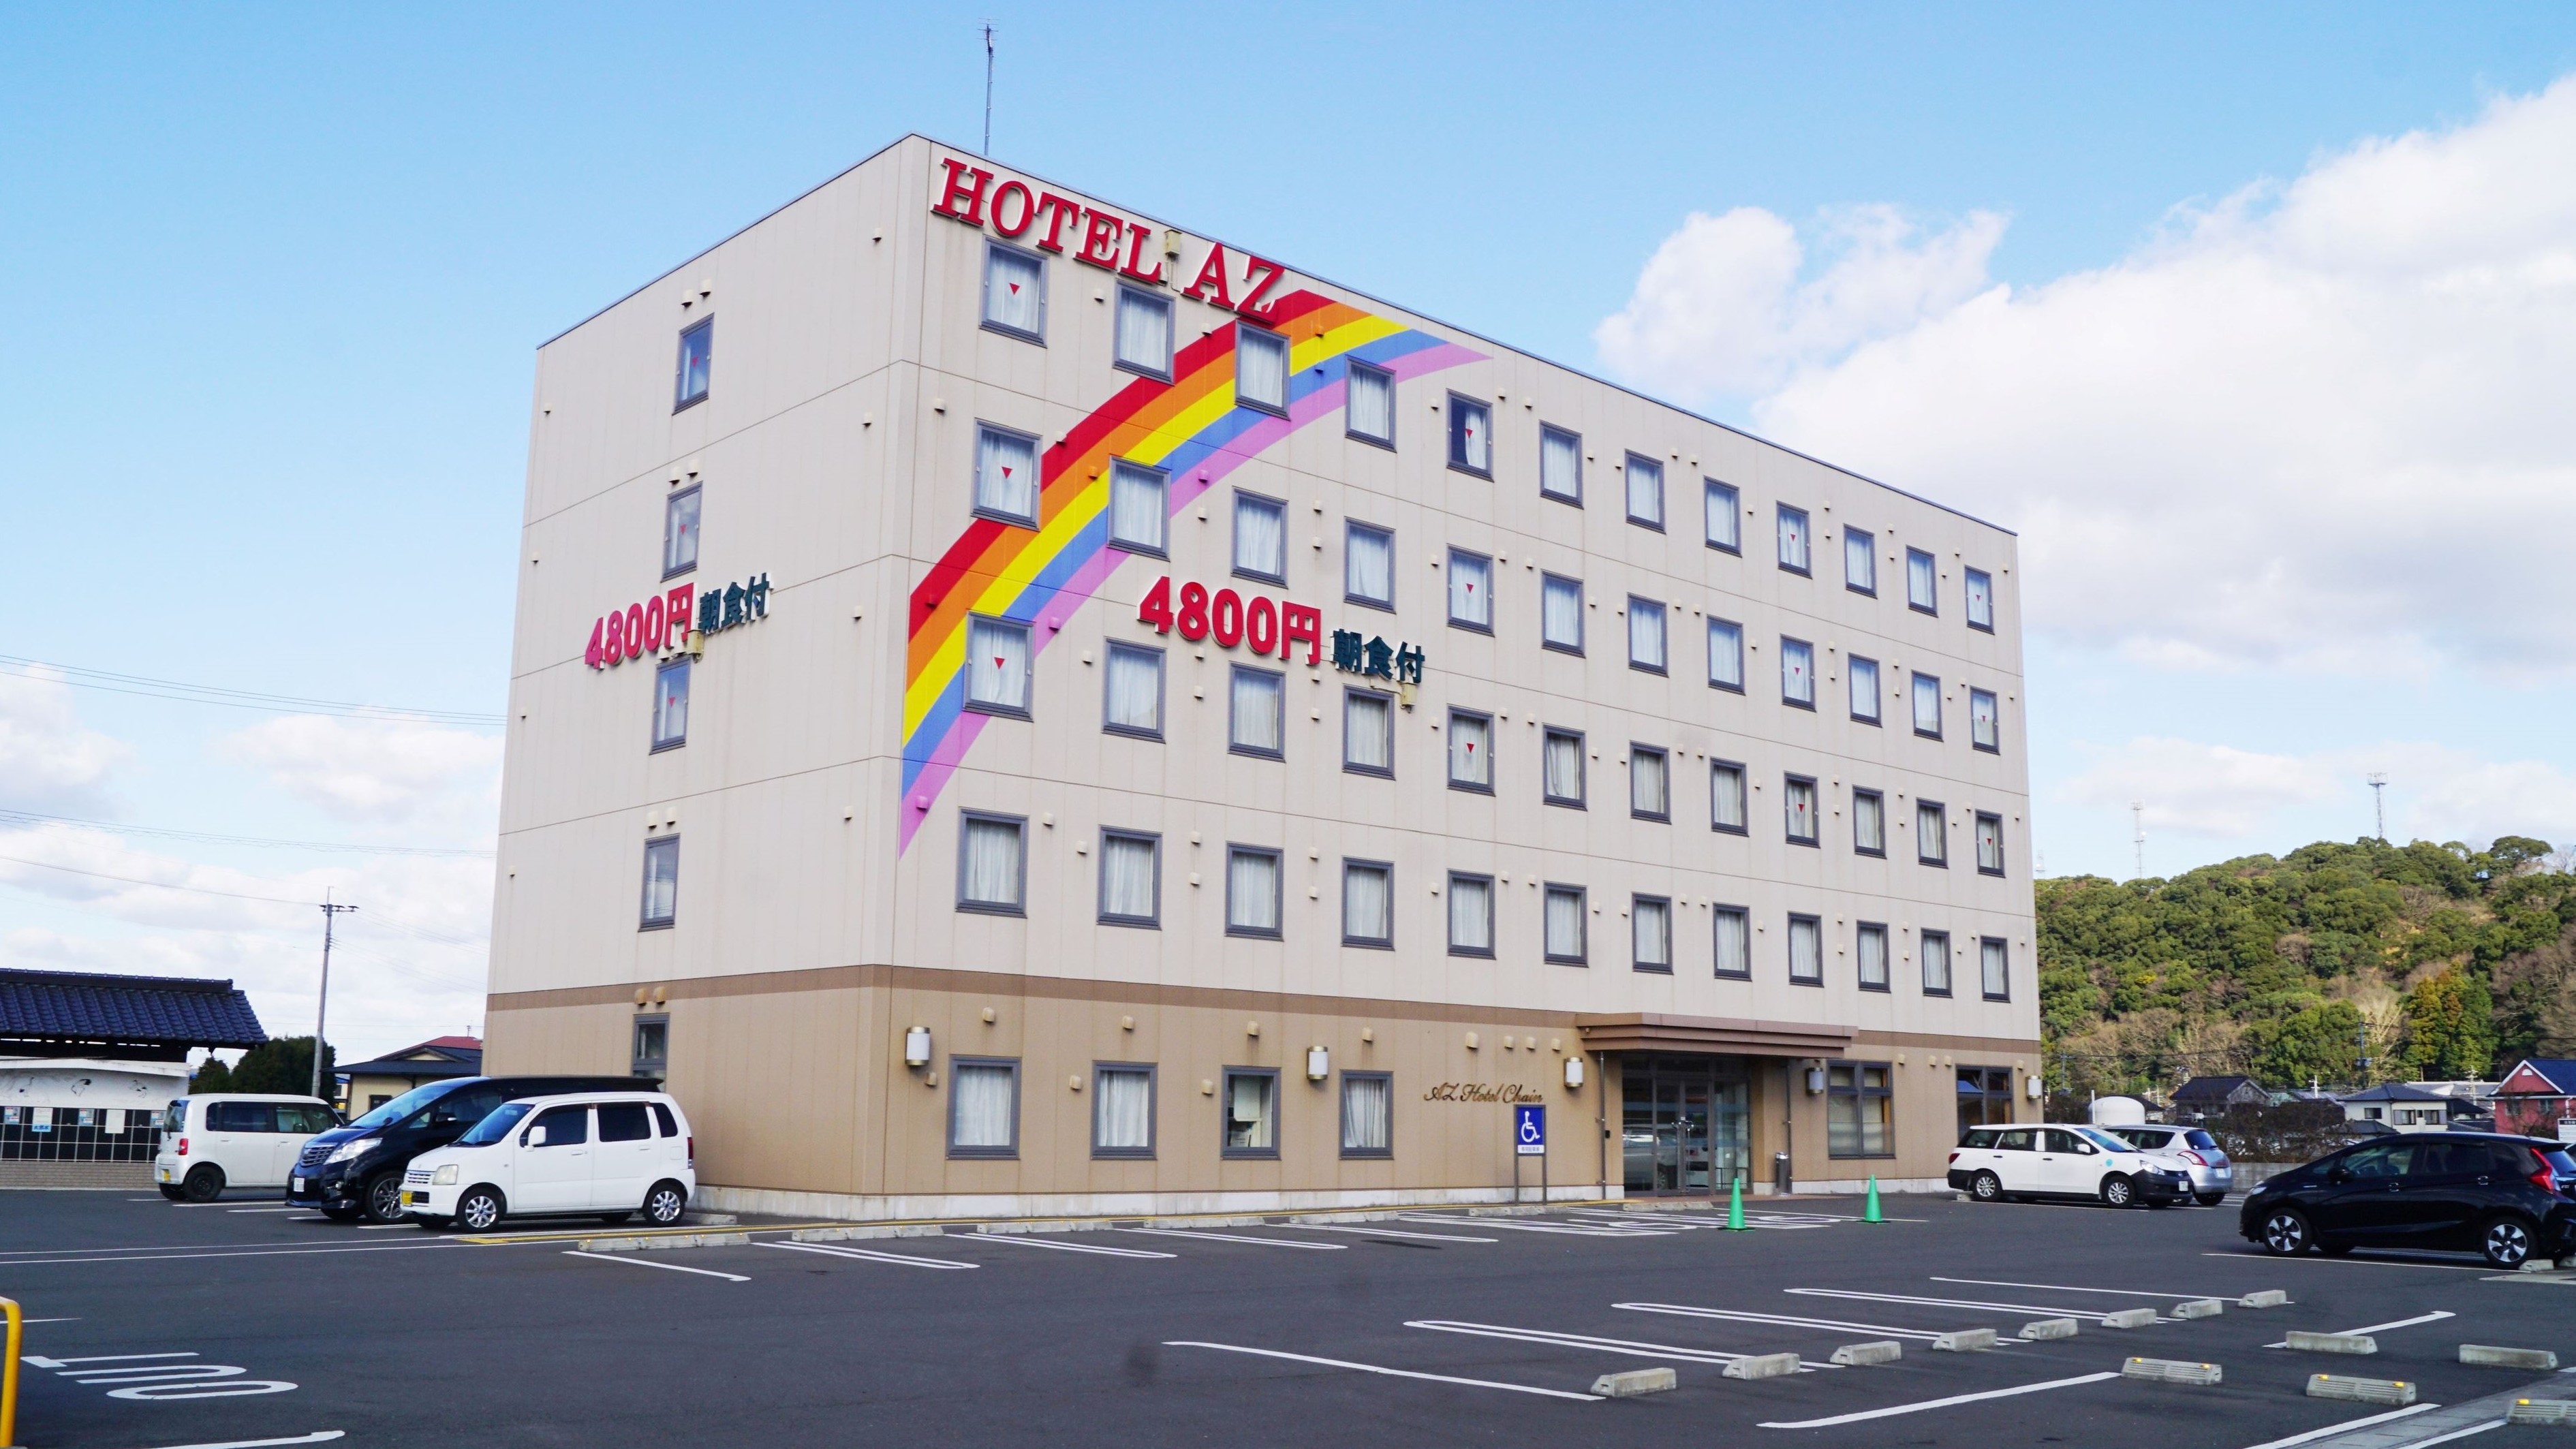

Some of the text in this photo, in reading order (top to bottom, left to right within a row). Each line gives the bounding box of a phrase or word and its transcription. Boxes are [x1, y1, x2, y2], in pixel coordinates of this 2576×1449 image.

[931, 157, 1285, 324] HOTEL AZ
[585, 572, 773, 670] 4800円 朝食付
[1137, 576, 1425, 683] 4800円 朝食付
[1423, 1082, 1543, 1104] AZ Hotel Chain
[20, 1352, 298, 1400] OUT
